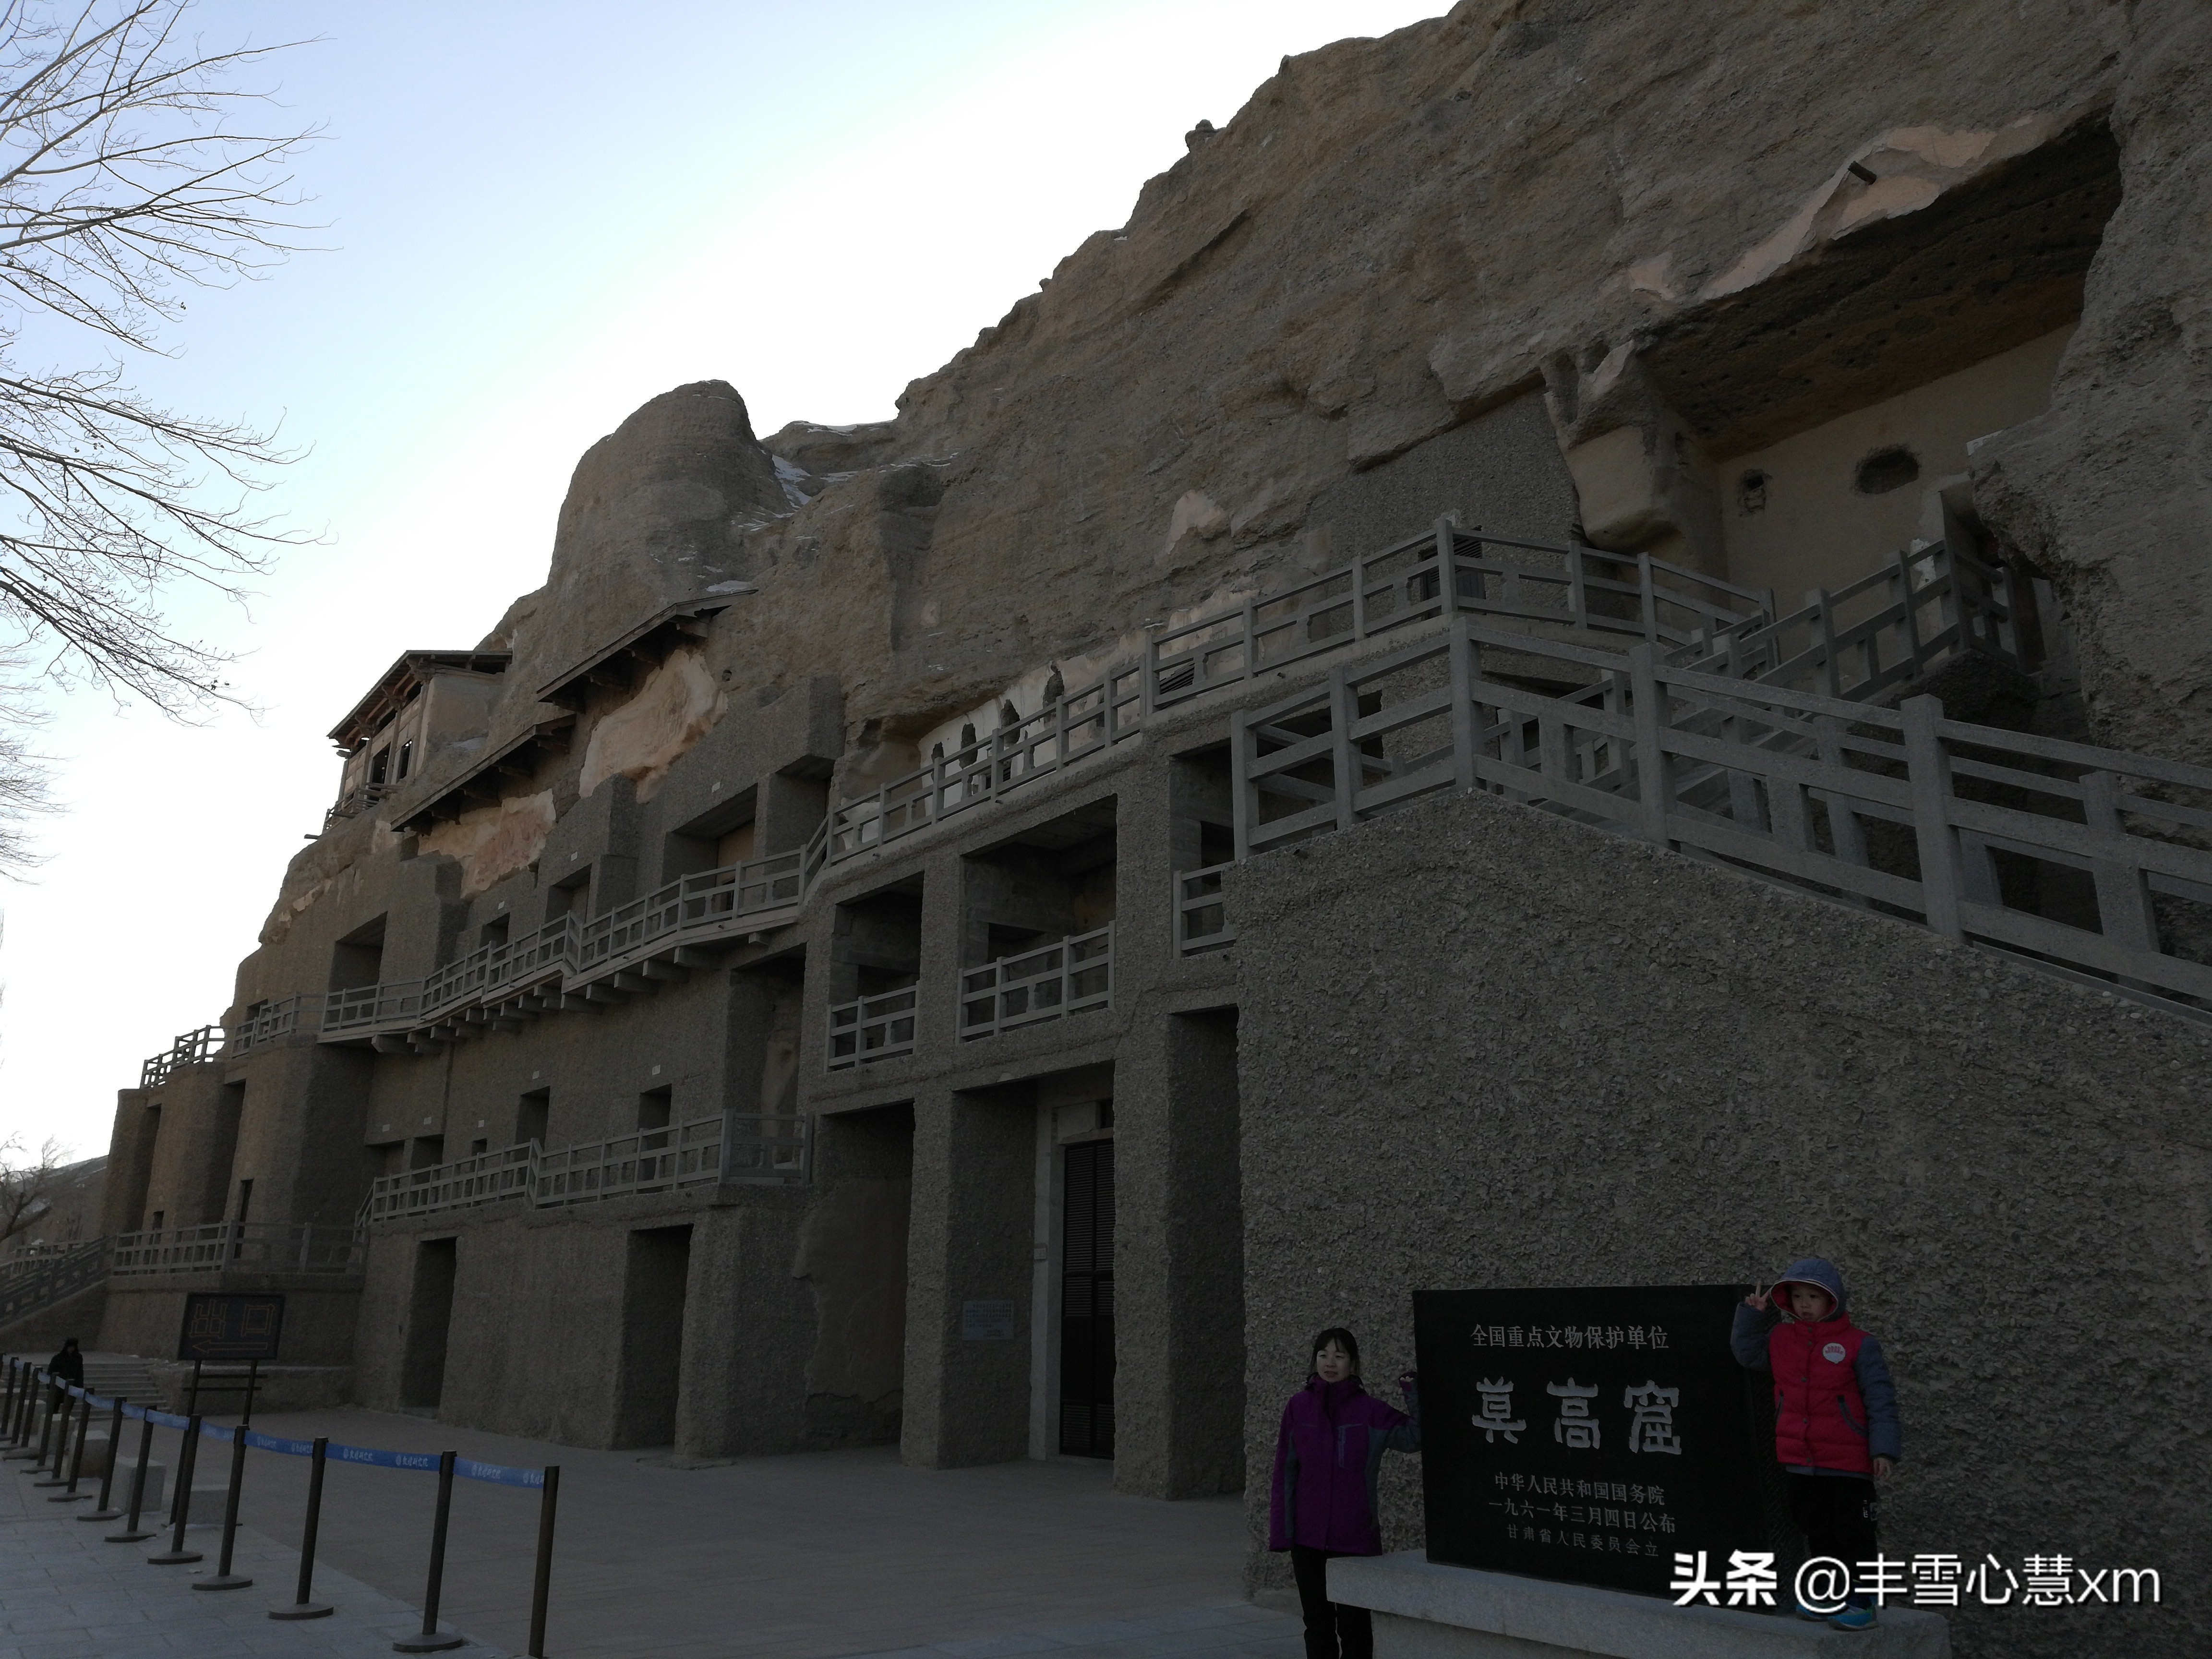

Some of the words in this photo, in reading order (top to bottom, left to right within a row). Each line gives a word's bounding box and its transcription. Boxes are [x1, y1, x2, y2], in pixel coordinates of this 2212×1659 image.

[189, 1299, 276, 1339] 出口
[1470, 1324, 1670, 1349] 全国重点文物保护单位
[1472, 1376, 1682, 1455] 莫高窟
[1494, 1471, 1665, 1505] 中华人民共和国国务院
[1489, 1498, 1676, 1533] 一九六一年三月四日公布
[1506, 1524, 1659, 1557] 甘肃省人民委员会立
